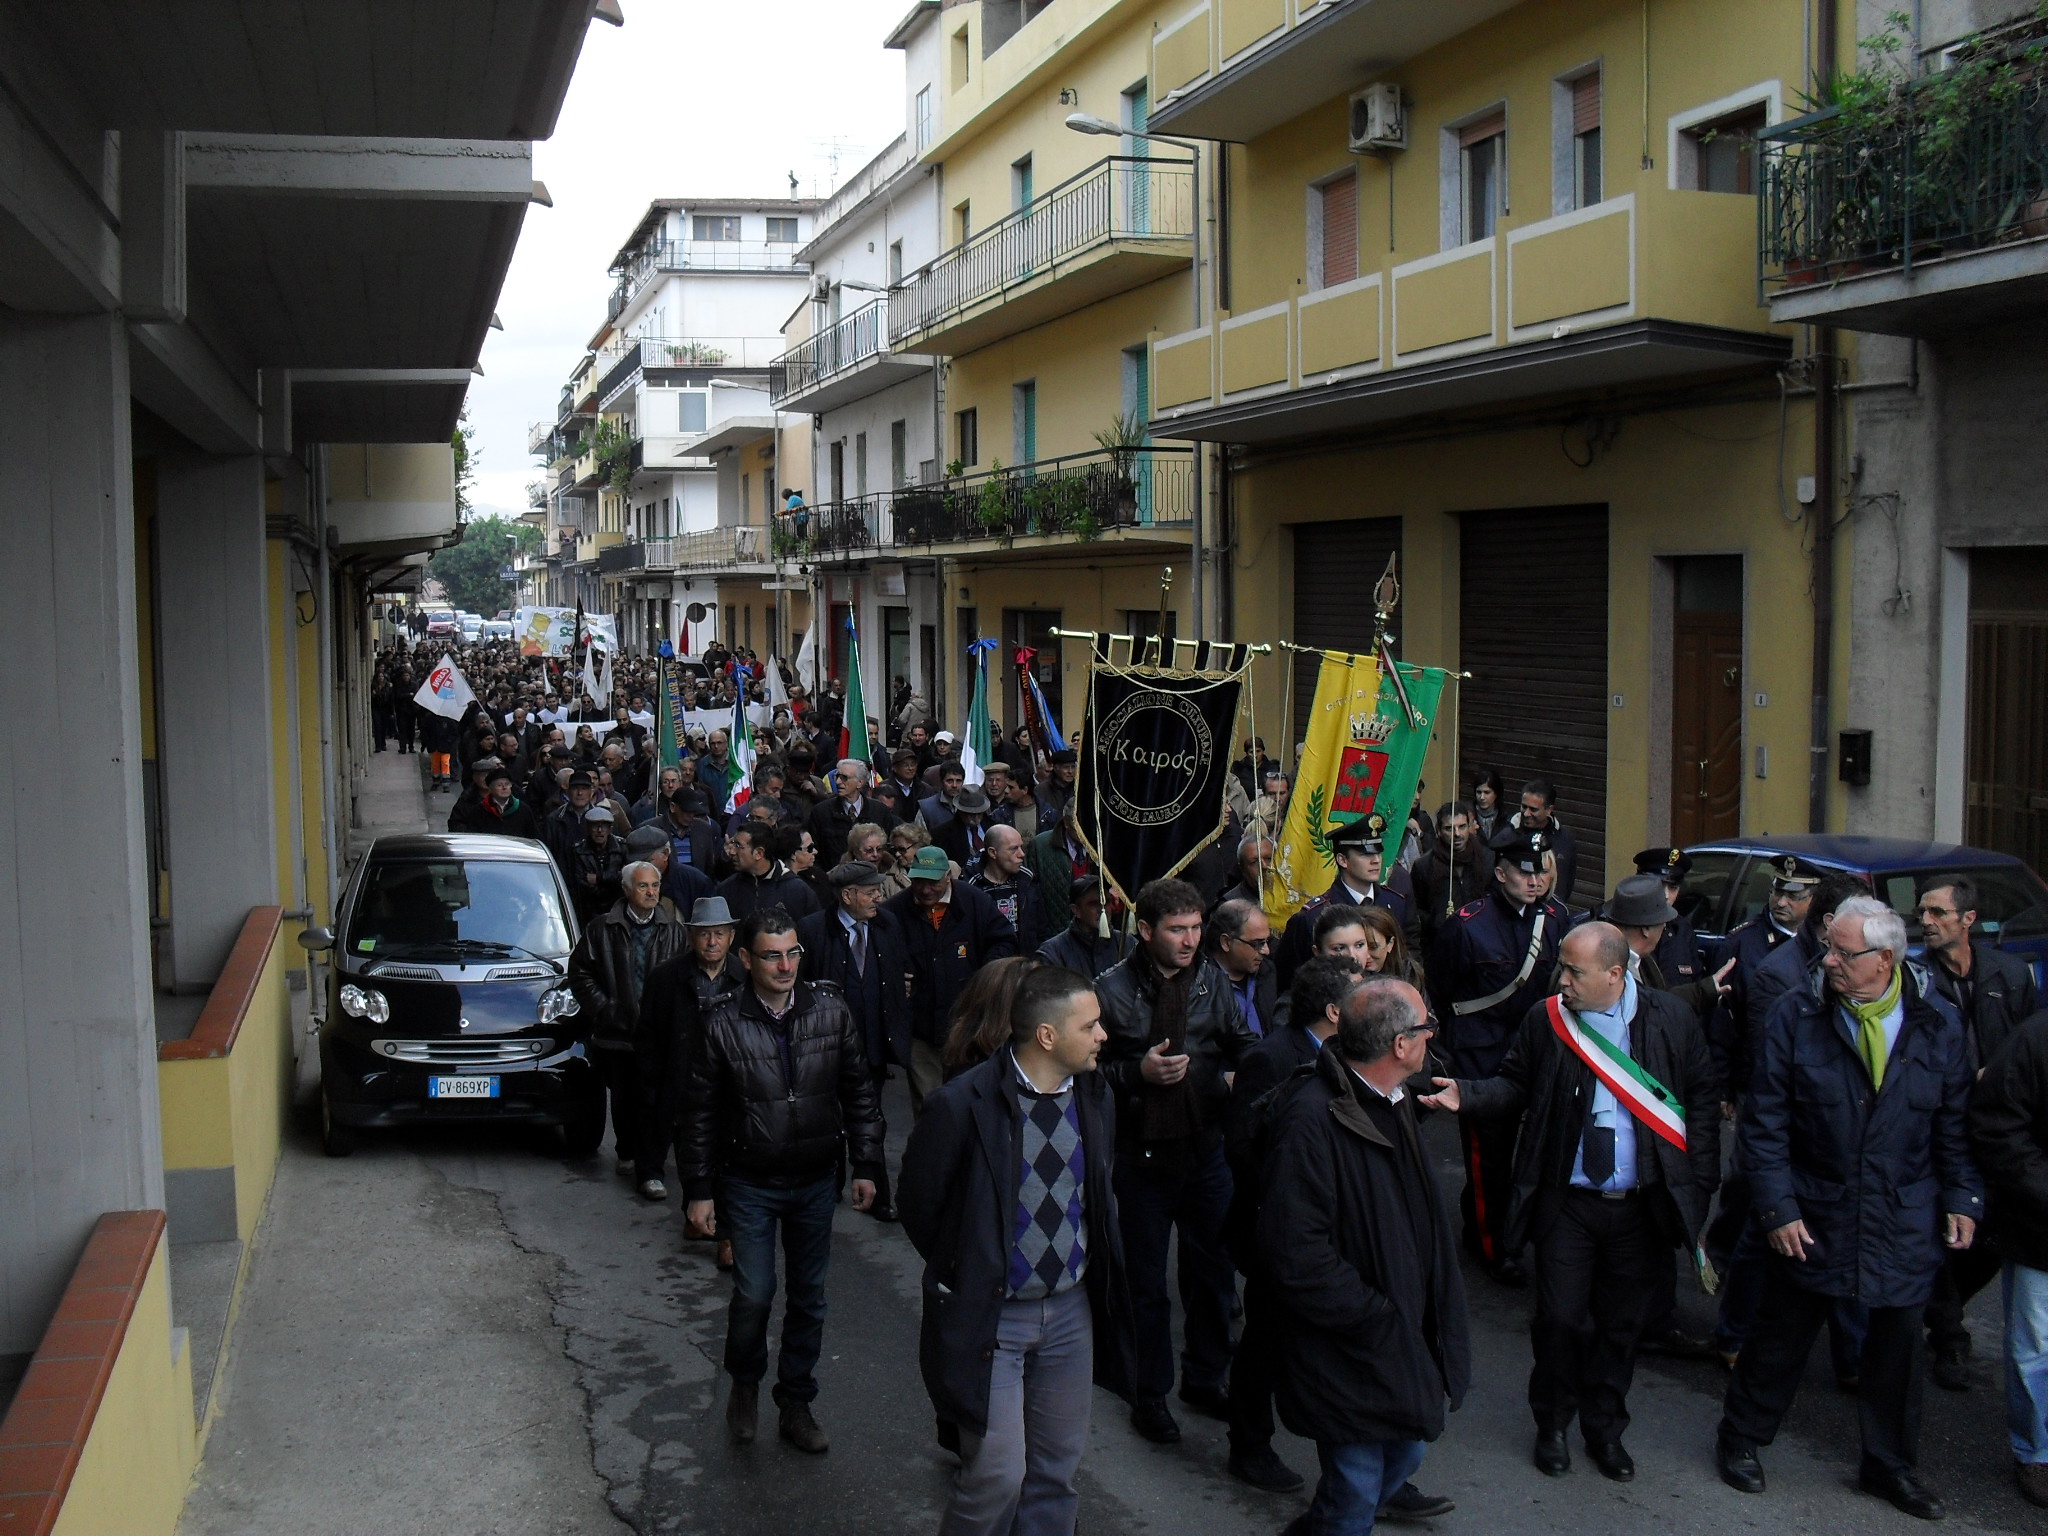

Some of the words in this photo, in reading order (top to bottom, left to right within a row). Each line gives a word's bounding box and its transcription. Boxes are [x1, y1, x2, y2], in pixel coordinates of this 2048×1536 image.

[1098, 693, 1174, 755] ASSOCIAZIONE
[1179, 700, 1211, 765] CULTURALE
[1110, 794, 1140, 823] GIOIA
[1142, 802, 1182, 823] TAURO
